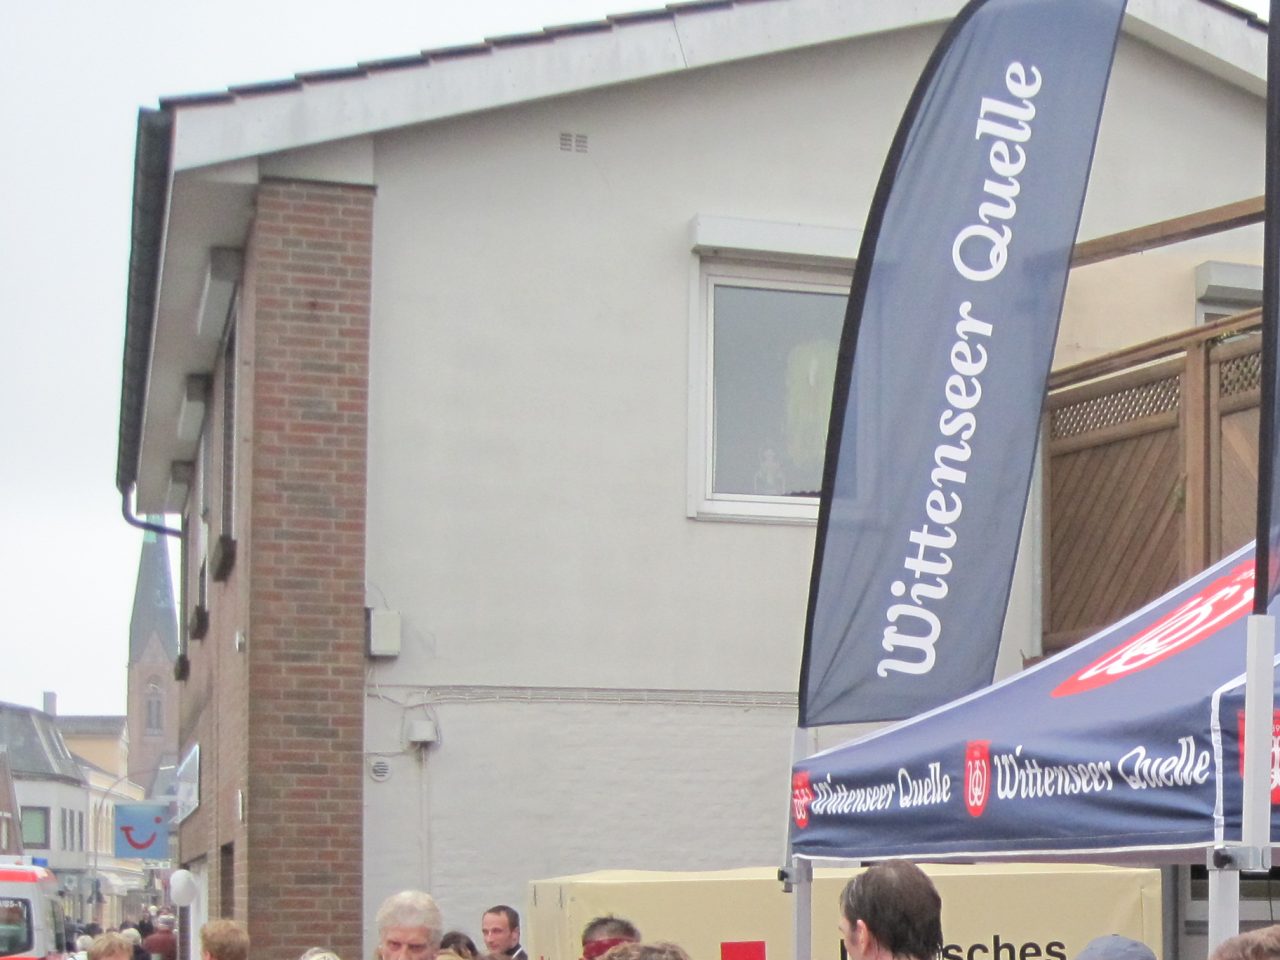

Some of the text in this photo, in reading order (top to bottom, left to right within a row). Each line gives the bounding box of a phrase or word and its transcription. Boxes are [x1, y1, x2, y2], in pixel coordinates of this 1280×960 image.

[877, 61, 1043, 678] Wittenseer Quelle
[811, 762, 951, 815] Wittenseer Quelle
[994, 736, 1211, 800] Wittenseer Quelle
